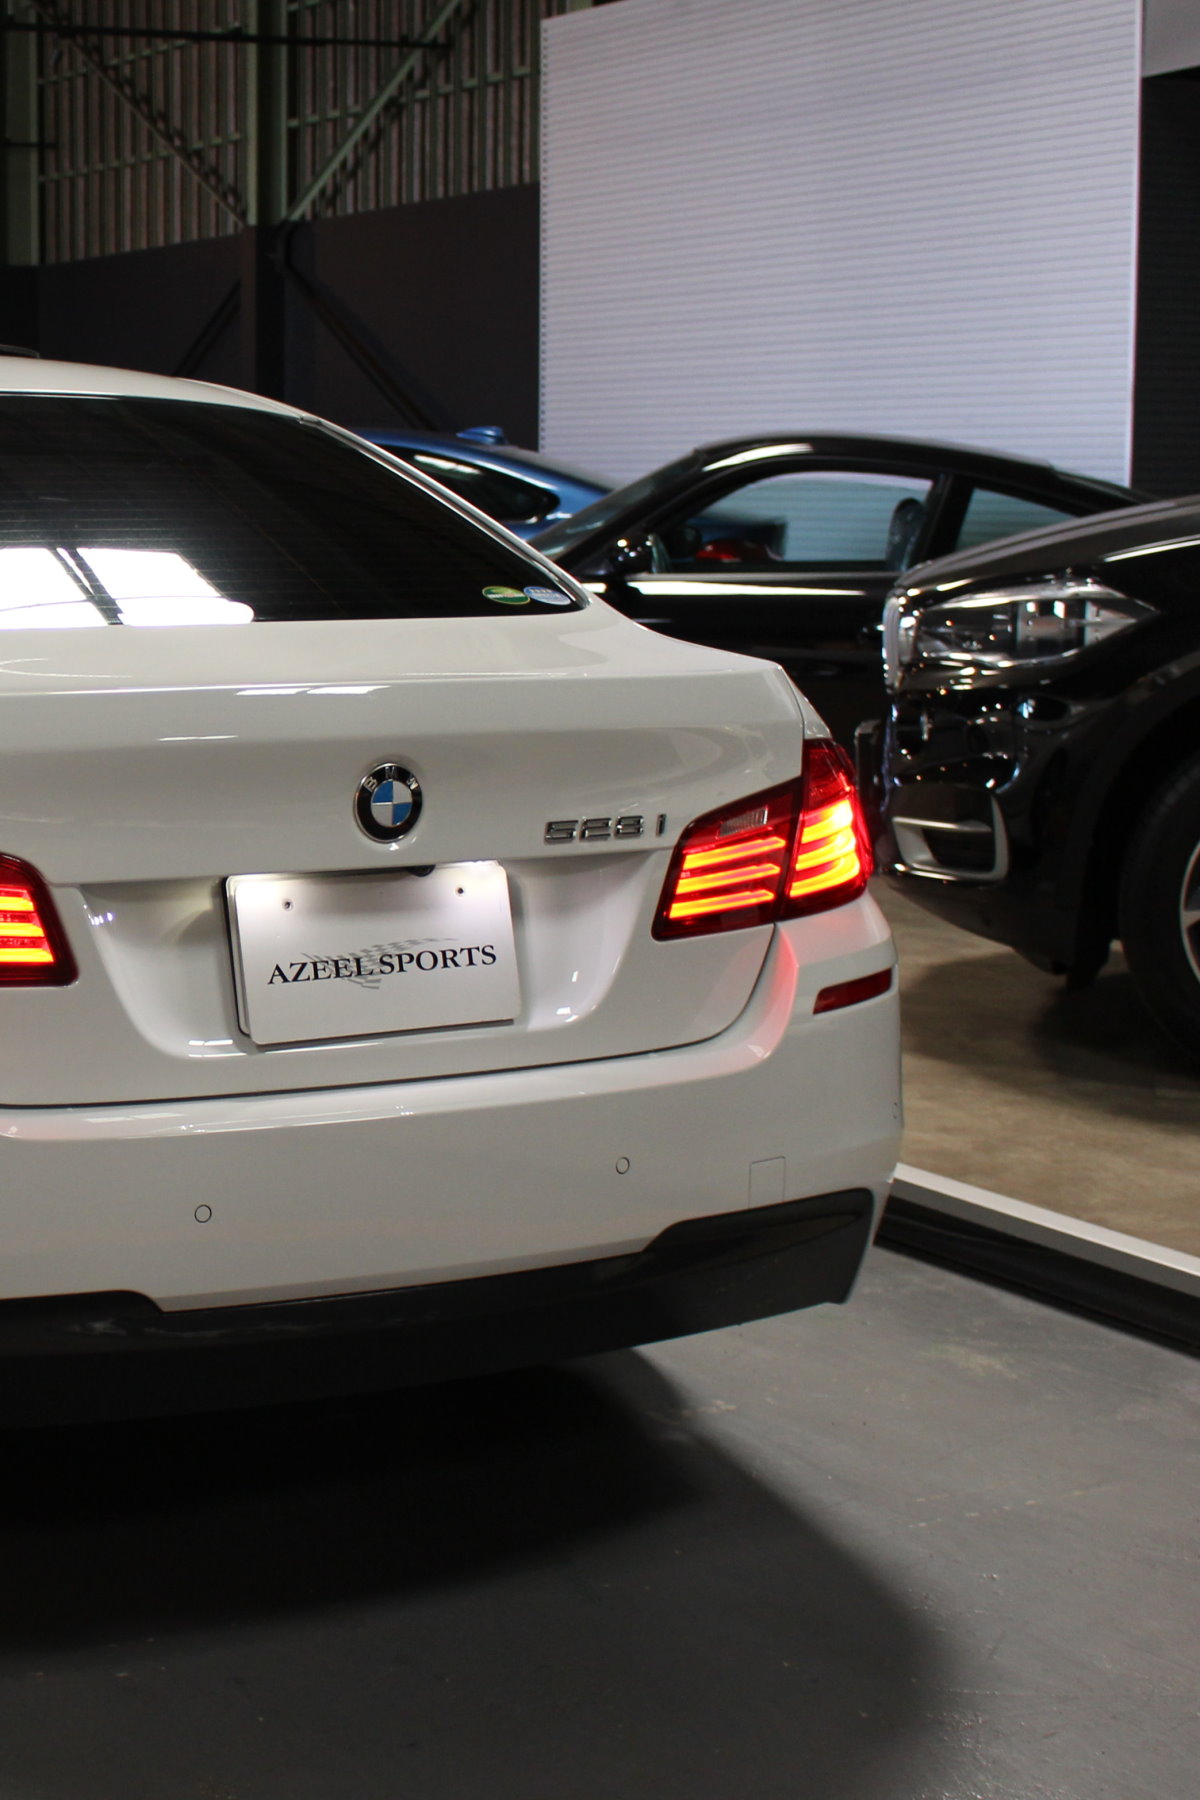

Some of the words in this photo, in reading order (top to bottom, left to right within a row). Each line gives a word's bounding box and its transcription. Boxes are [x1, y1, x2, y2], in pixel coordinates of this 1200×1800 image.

[363, 766, 419, 792] BMW
[267, 957, 374, 985] AZEEL
[378, 944, 498, 975] SPORTS
